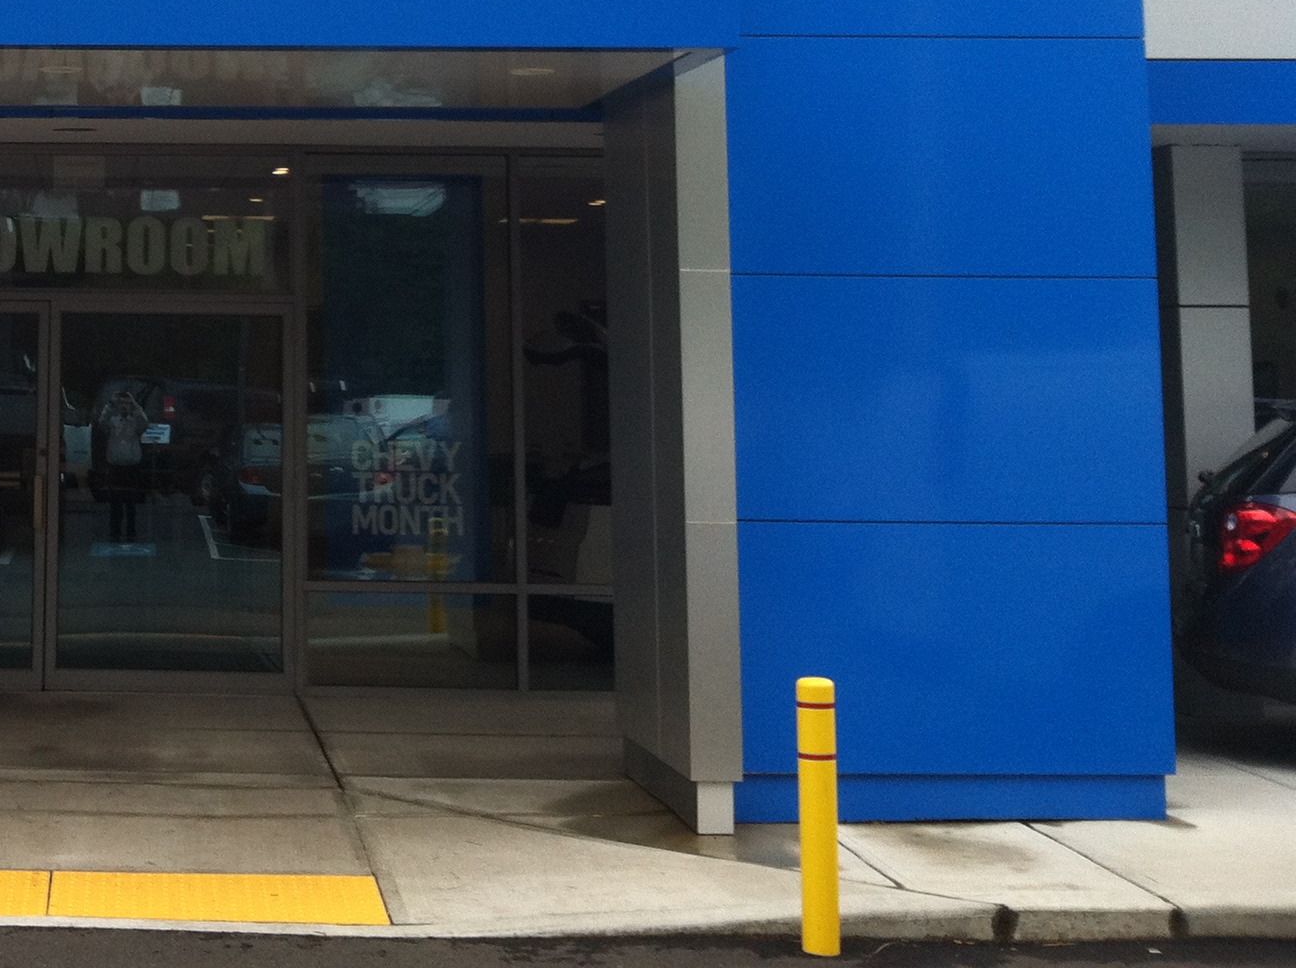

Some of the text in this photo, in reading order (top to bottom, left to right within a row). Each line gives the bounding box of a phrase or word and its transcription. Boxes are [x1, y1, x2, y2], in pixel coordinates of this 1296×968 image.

[350, 438, 462, 472] CHEVY
[351, 471, 463, 505] TRUCK
[350, 503, 464, 537] MONTH
